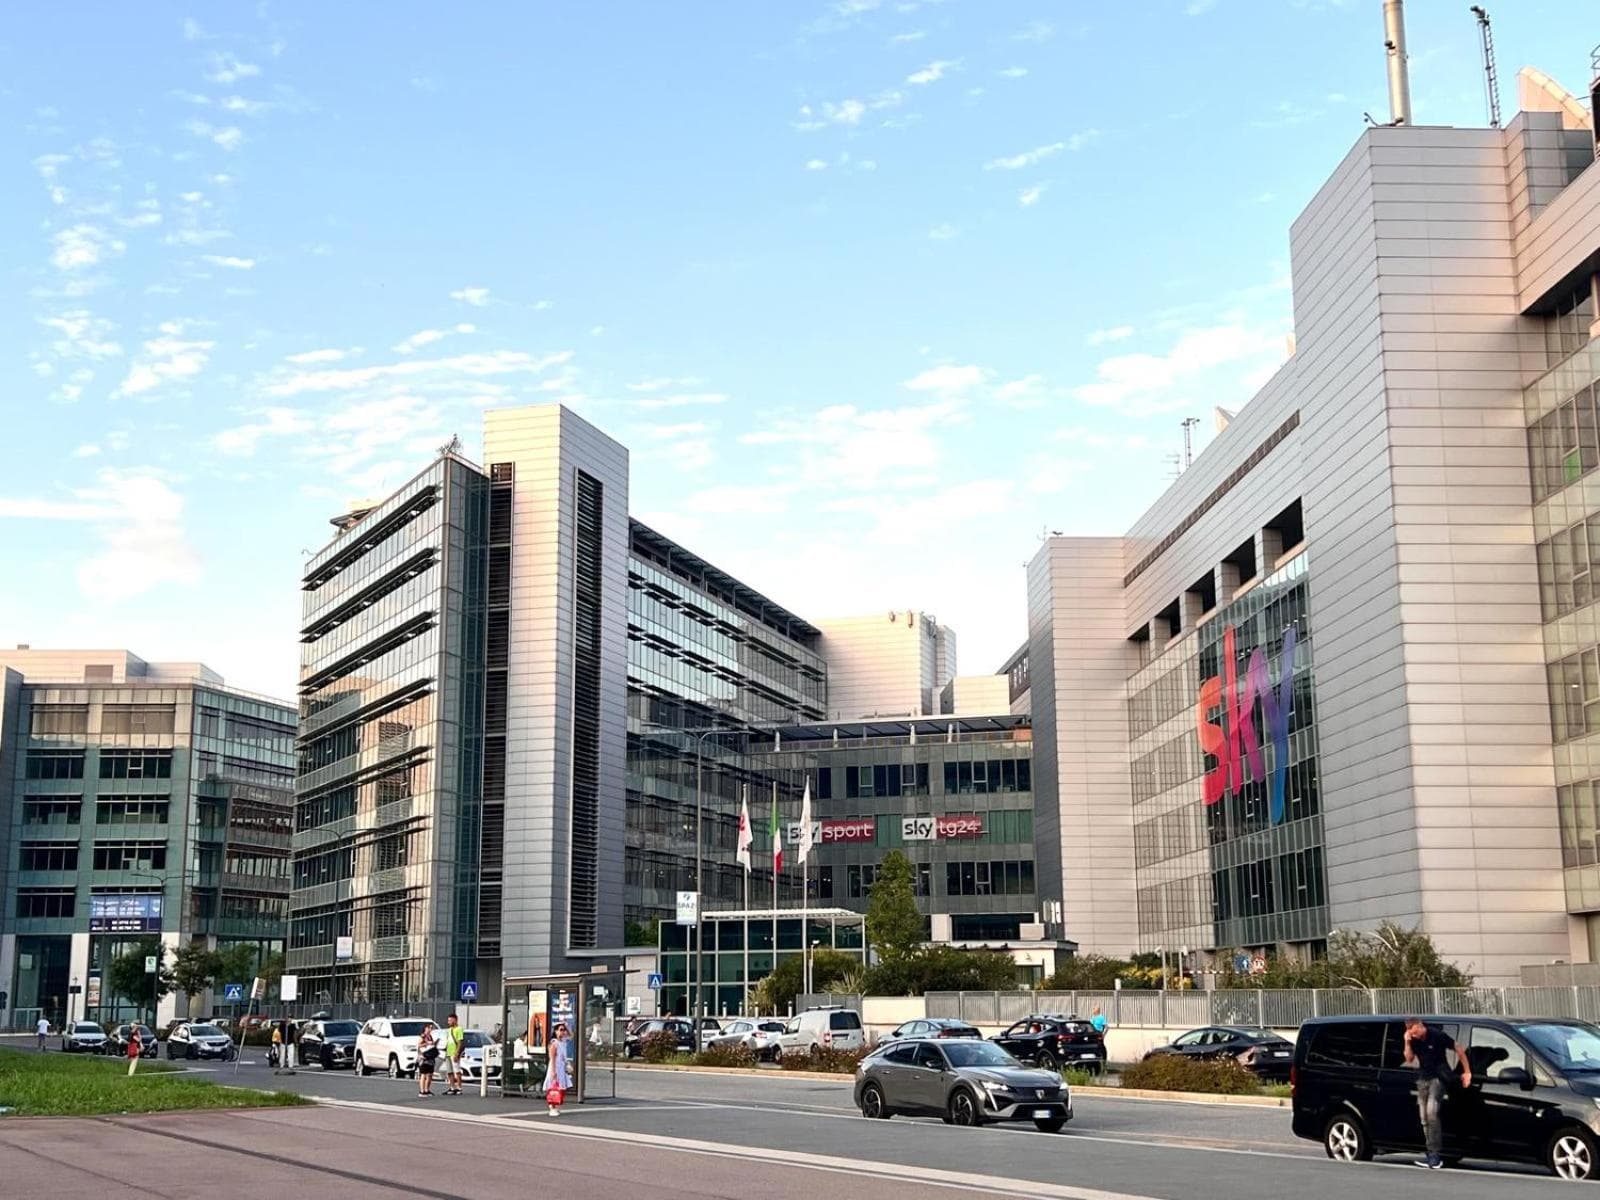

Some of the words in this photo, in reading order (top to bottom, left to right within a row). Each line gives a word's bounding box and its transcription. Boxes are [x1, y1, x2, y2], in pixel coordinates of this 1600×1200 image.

[1197, 623, 1297, 826] sky
[790, 824, 819, 841] sy
[823, 823, 874, 841] sport
[904, 819, 933, 838] sky
[939, 819, 981, 837] tg24
